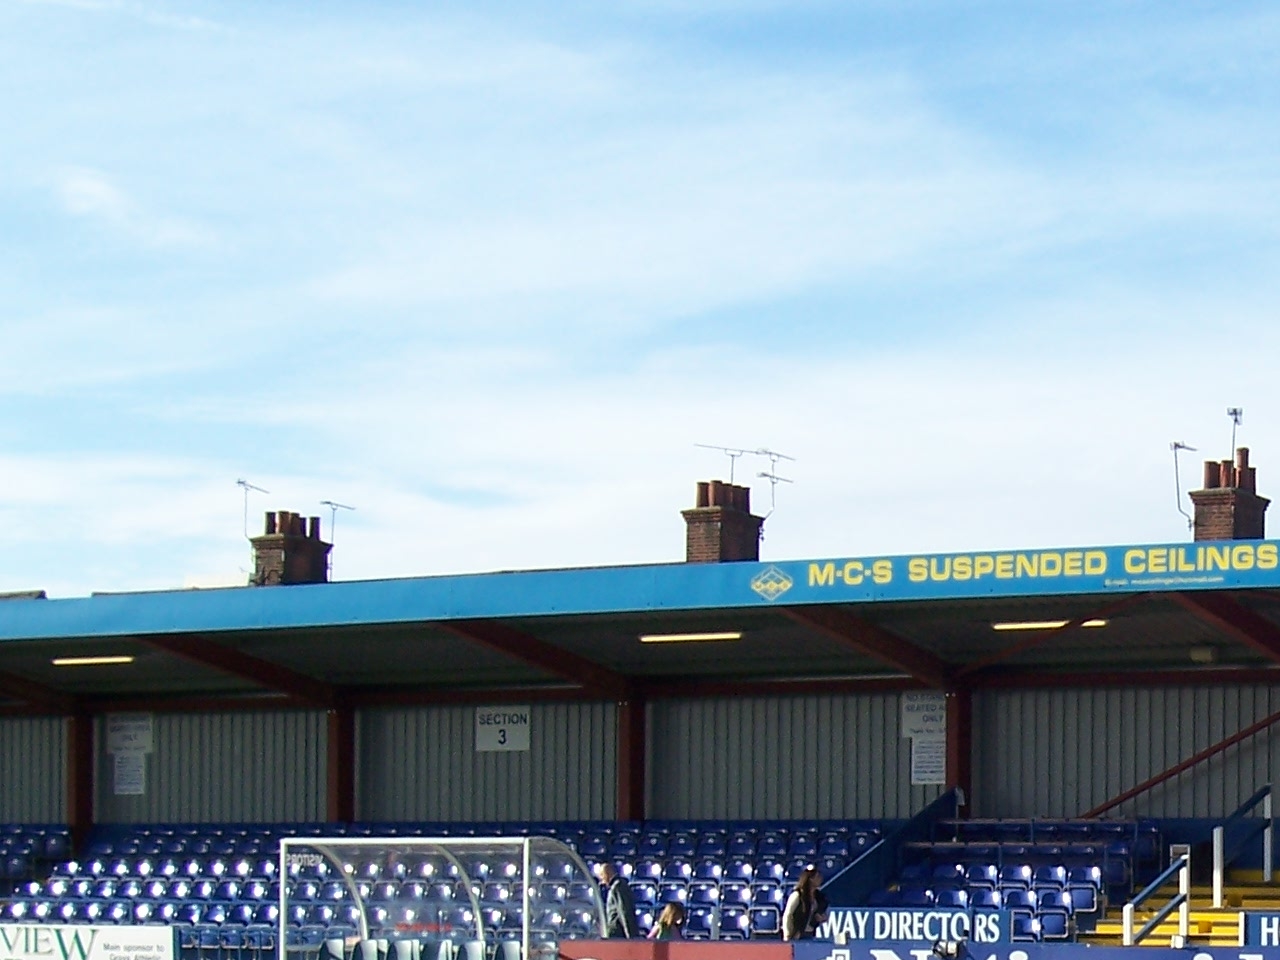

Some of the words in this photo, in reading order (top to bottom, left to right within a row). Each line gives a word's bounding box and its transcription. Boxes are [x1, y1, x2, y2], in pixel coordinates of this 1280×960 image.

[908, 549, 1108, 582] SUSPENDED
[1124, 544, 1279, 574] CEILINGS
[479, 713, 528, 725] SECTION
[498, 729, 507, 745] 3
[815, 911, 869, 939] WAY
[874, 911, 1000, 943] DIRECTORS
